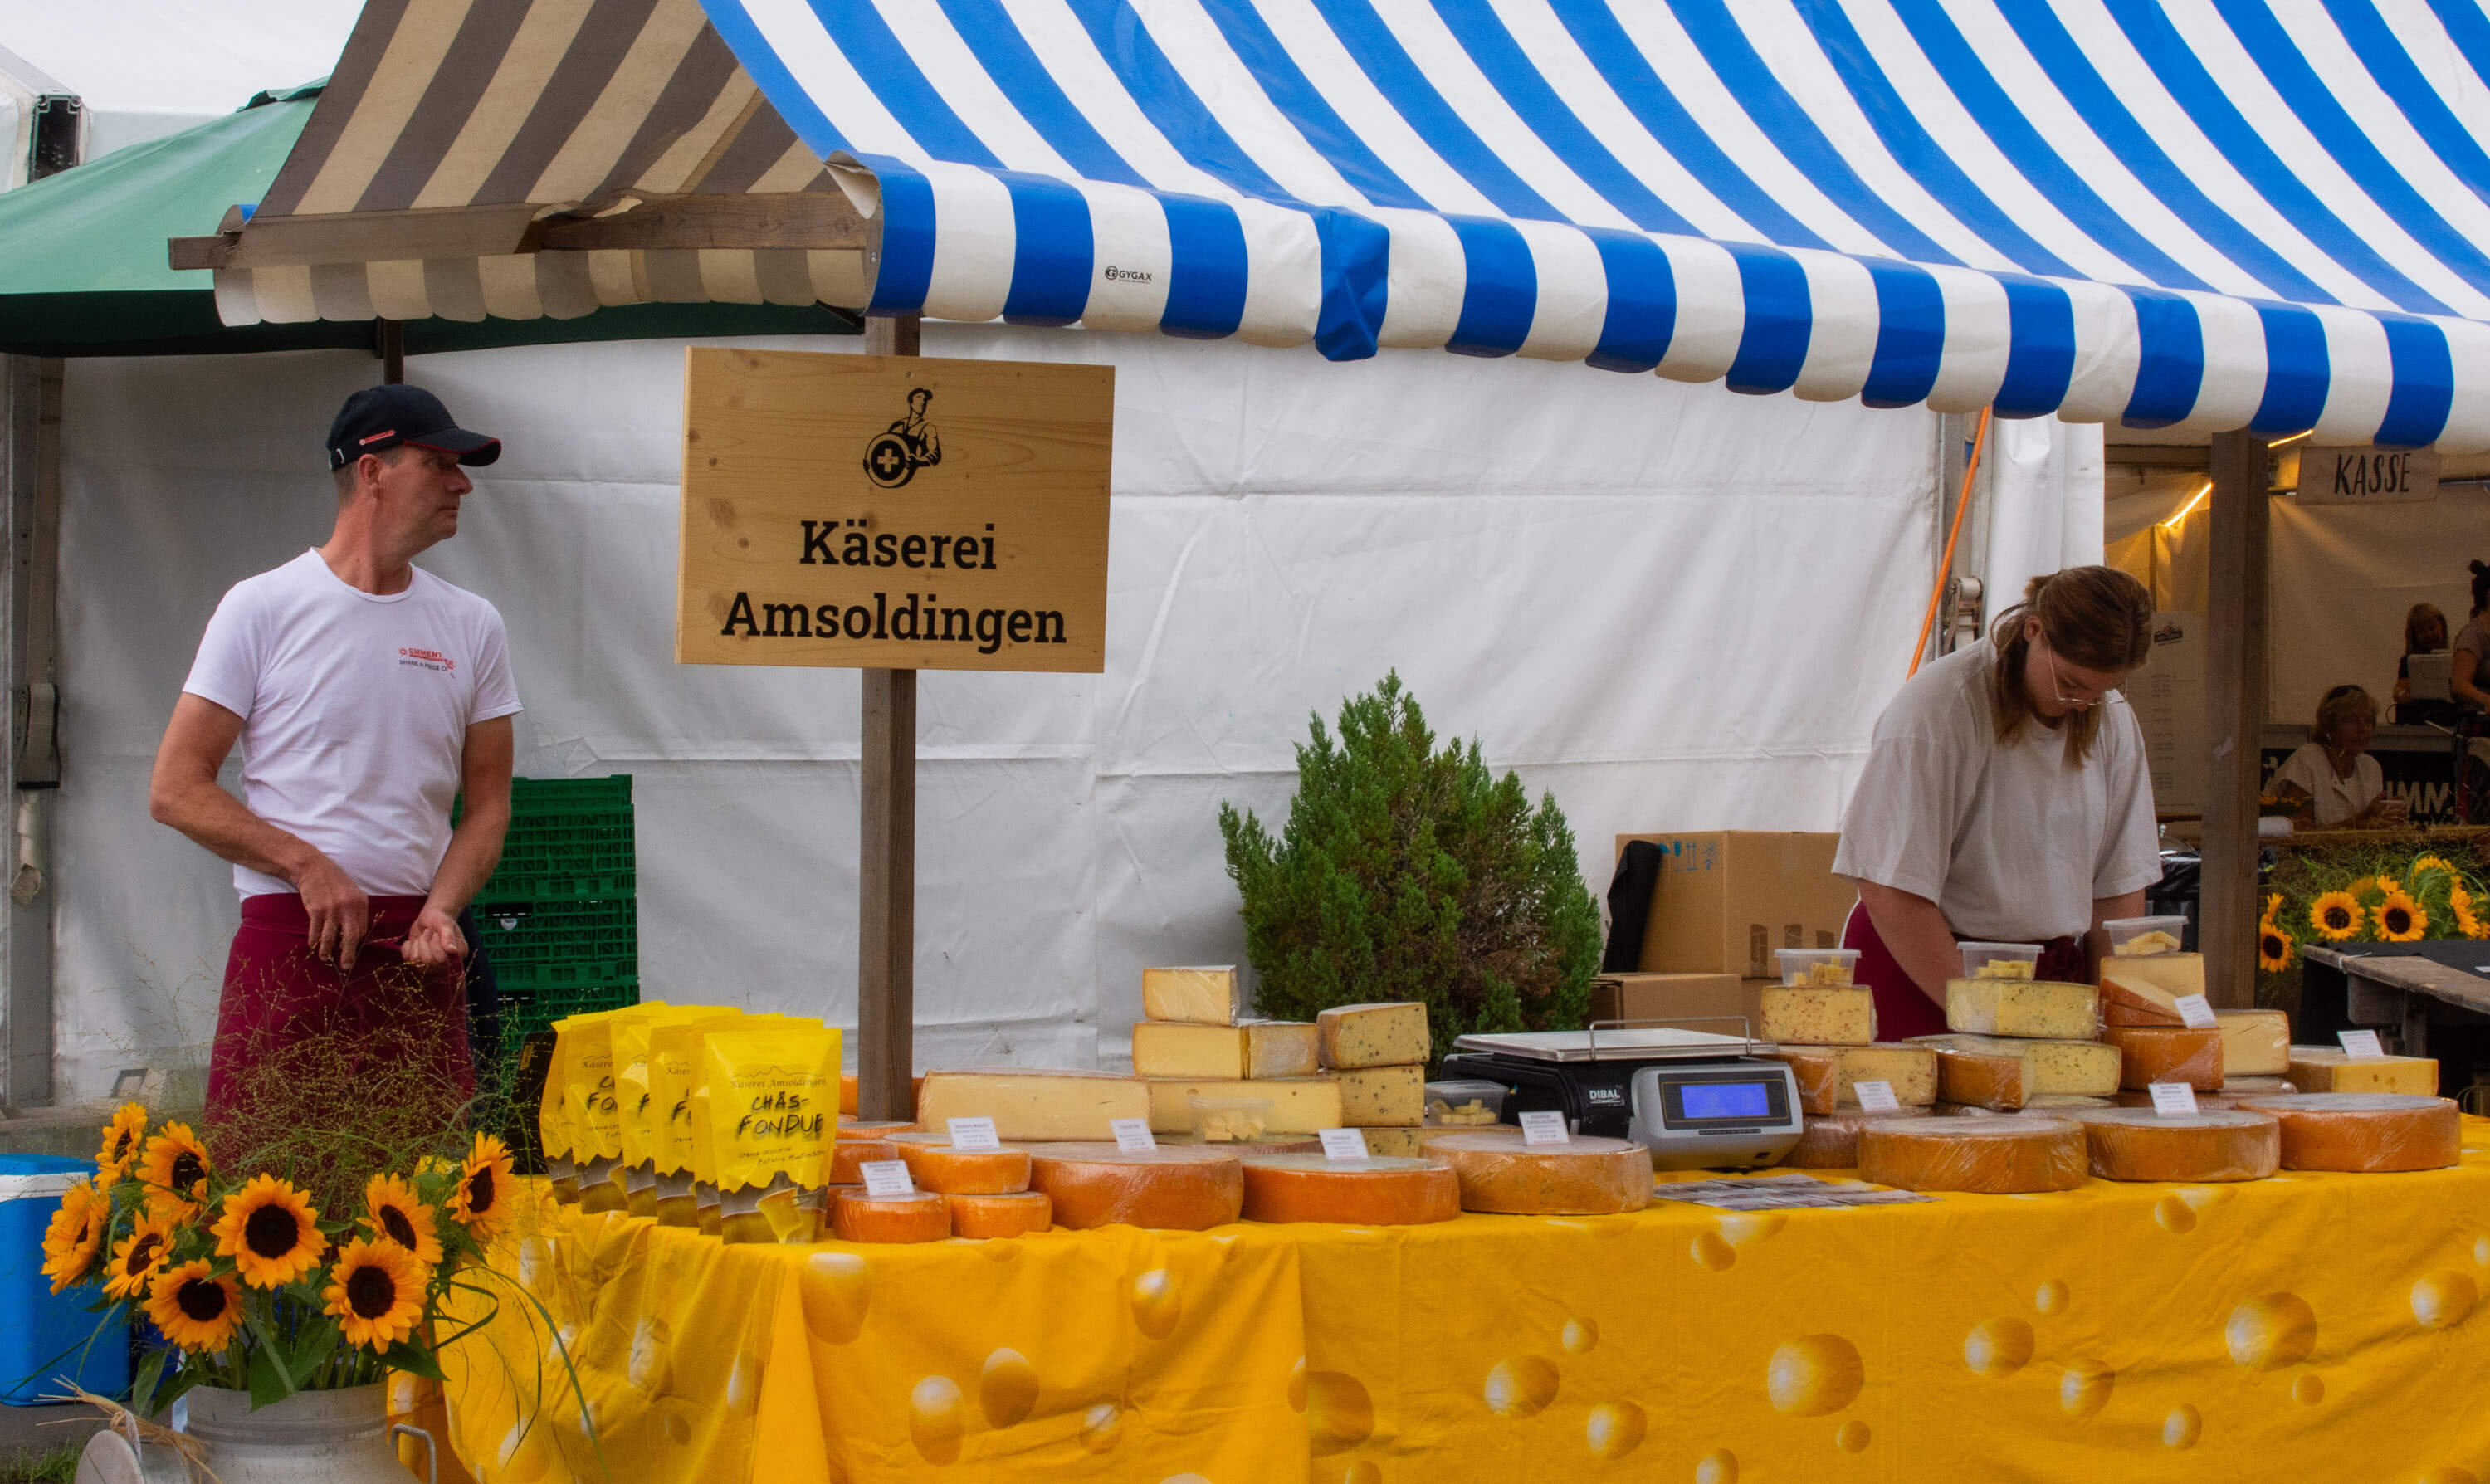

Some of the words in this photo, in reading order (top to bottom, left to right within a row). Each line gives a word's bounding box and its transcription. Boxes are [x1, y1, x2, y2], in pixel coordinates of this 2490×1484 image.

[1119, 270, 1152, 281] GYGAX
[2334, 452, 2411, 495] KASSE
[799, 519, 996, 569] Käserei
[721, 592, 1067, 654] Amsoldingen
[751, 1091, 810, 1111] CHÄS-
[1589, 1089, 1621, 1100] DIBAL
[737, 1113, 824, 1136] FONDUE
